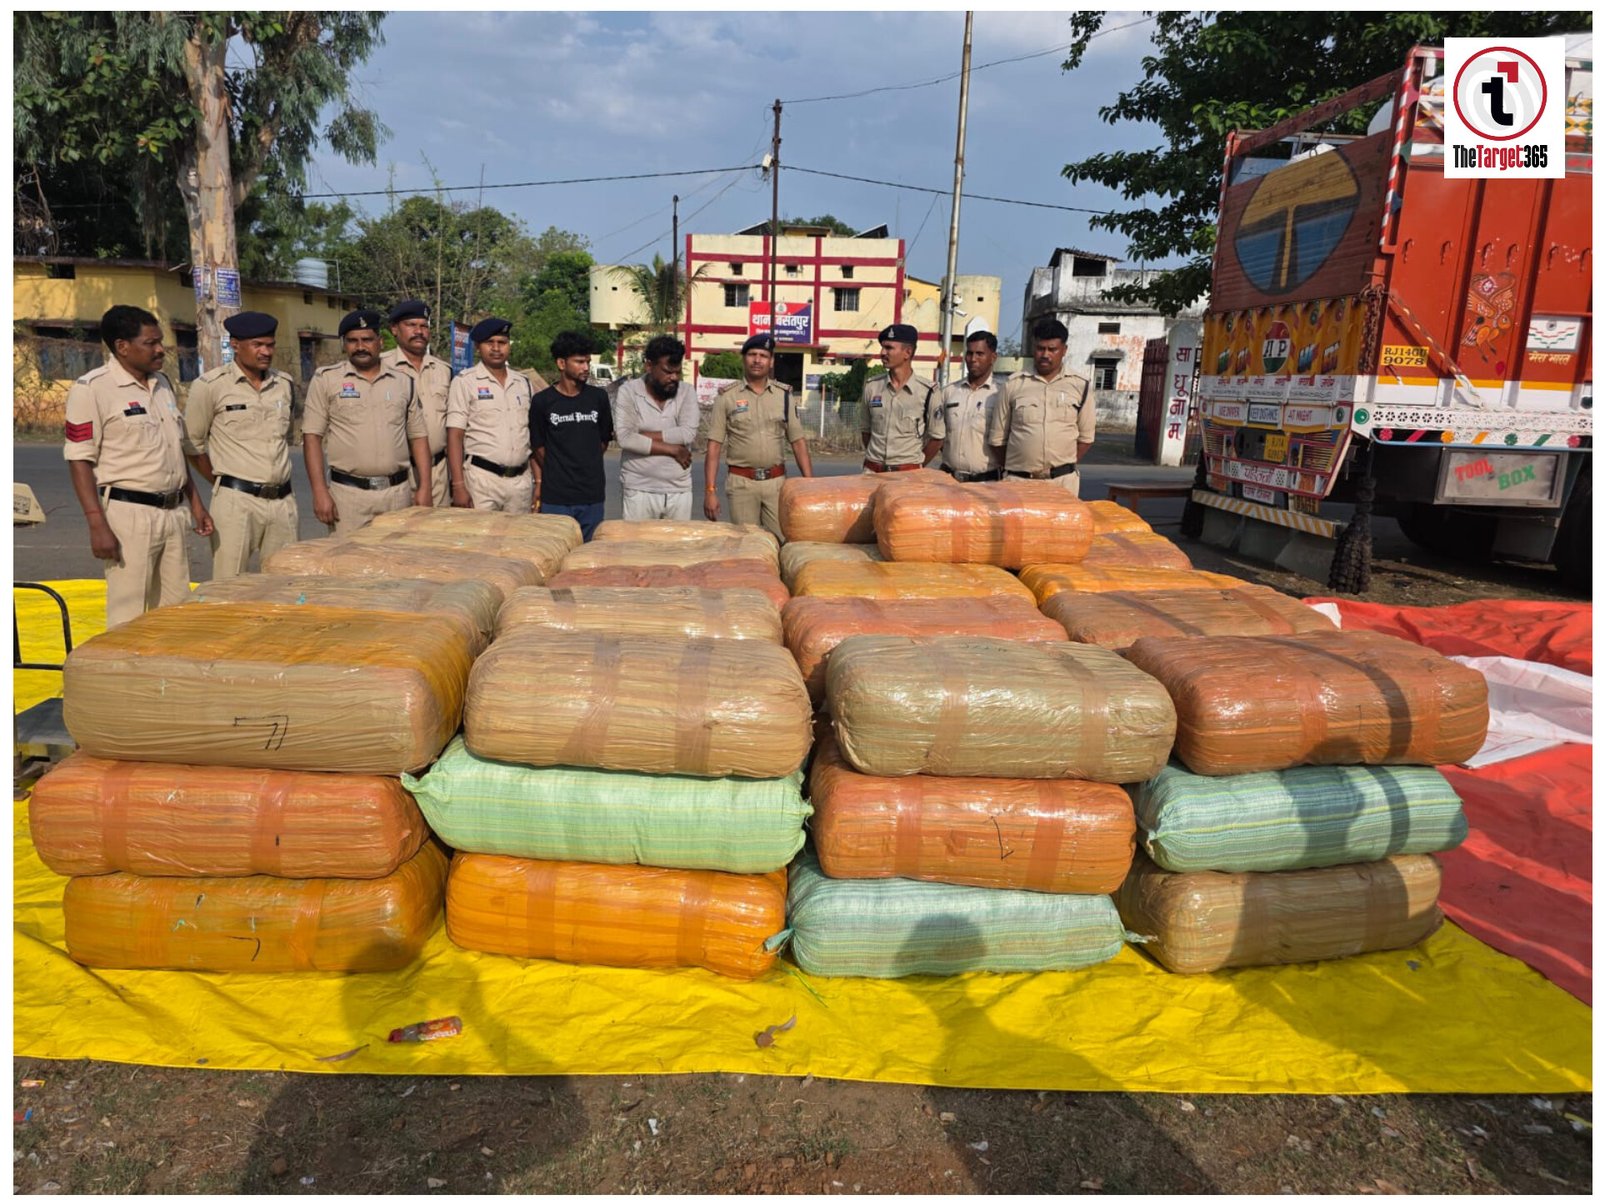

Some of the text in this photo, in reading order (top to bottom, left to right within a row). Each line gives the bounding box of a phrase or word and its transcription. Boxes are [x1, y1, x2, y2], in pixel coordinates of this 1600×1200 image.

[752, 313, 771, 326] थान
[1383, 356, 1425, 366] 9078
[1528, 351, 1571, 366] मेरा भारत
[1287, 410, 1313, 423] AT NIGHT
[1455, 457, 1494, 481] TOOL
[1497, 464, 1536, 491] BOX
